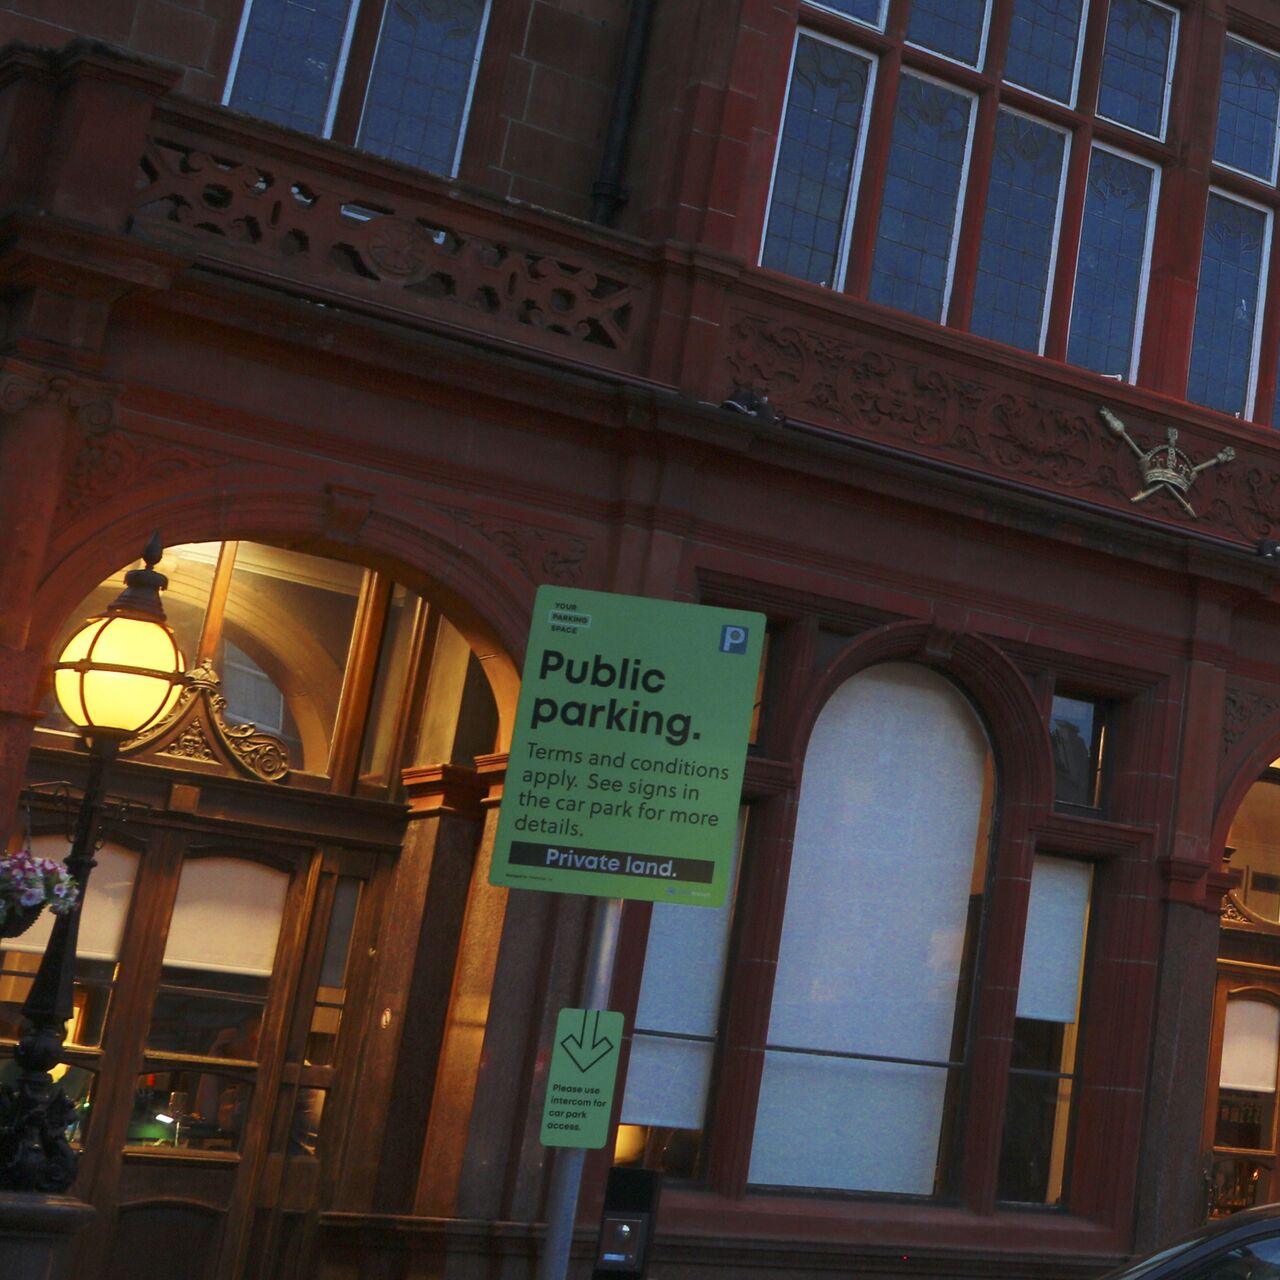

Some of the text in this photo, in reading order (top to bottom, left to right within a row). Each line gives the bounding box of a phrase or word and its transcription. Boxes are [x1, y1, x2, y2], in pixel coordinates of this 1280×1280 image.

[555, 602, 577, 611] YOUR
[552, 613, 589, 624] PARKING
[551, 625, 577, 634] SPACE
[539, 650, 666, 693] Public
[530, 696, 701, 746] parking.
[527, 742, 729, 780] Terms and conditions
[522, 770, 699, 801] apply. See signs in
[518, 791, 719, 826] the car park for more
[514, 815, 584, 837] details.
[545, 848, 678, 877] Private land.
[553, 1084, 583, 1094] Please
[550, 1096, 607, 1107] intercom for
[566, 1111, 587, 1119] park
[547, 1122, 581, 1131] access.
